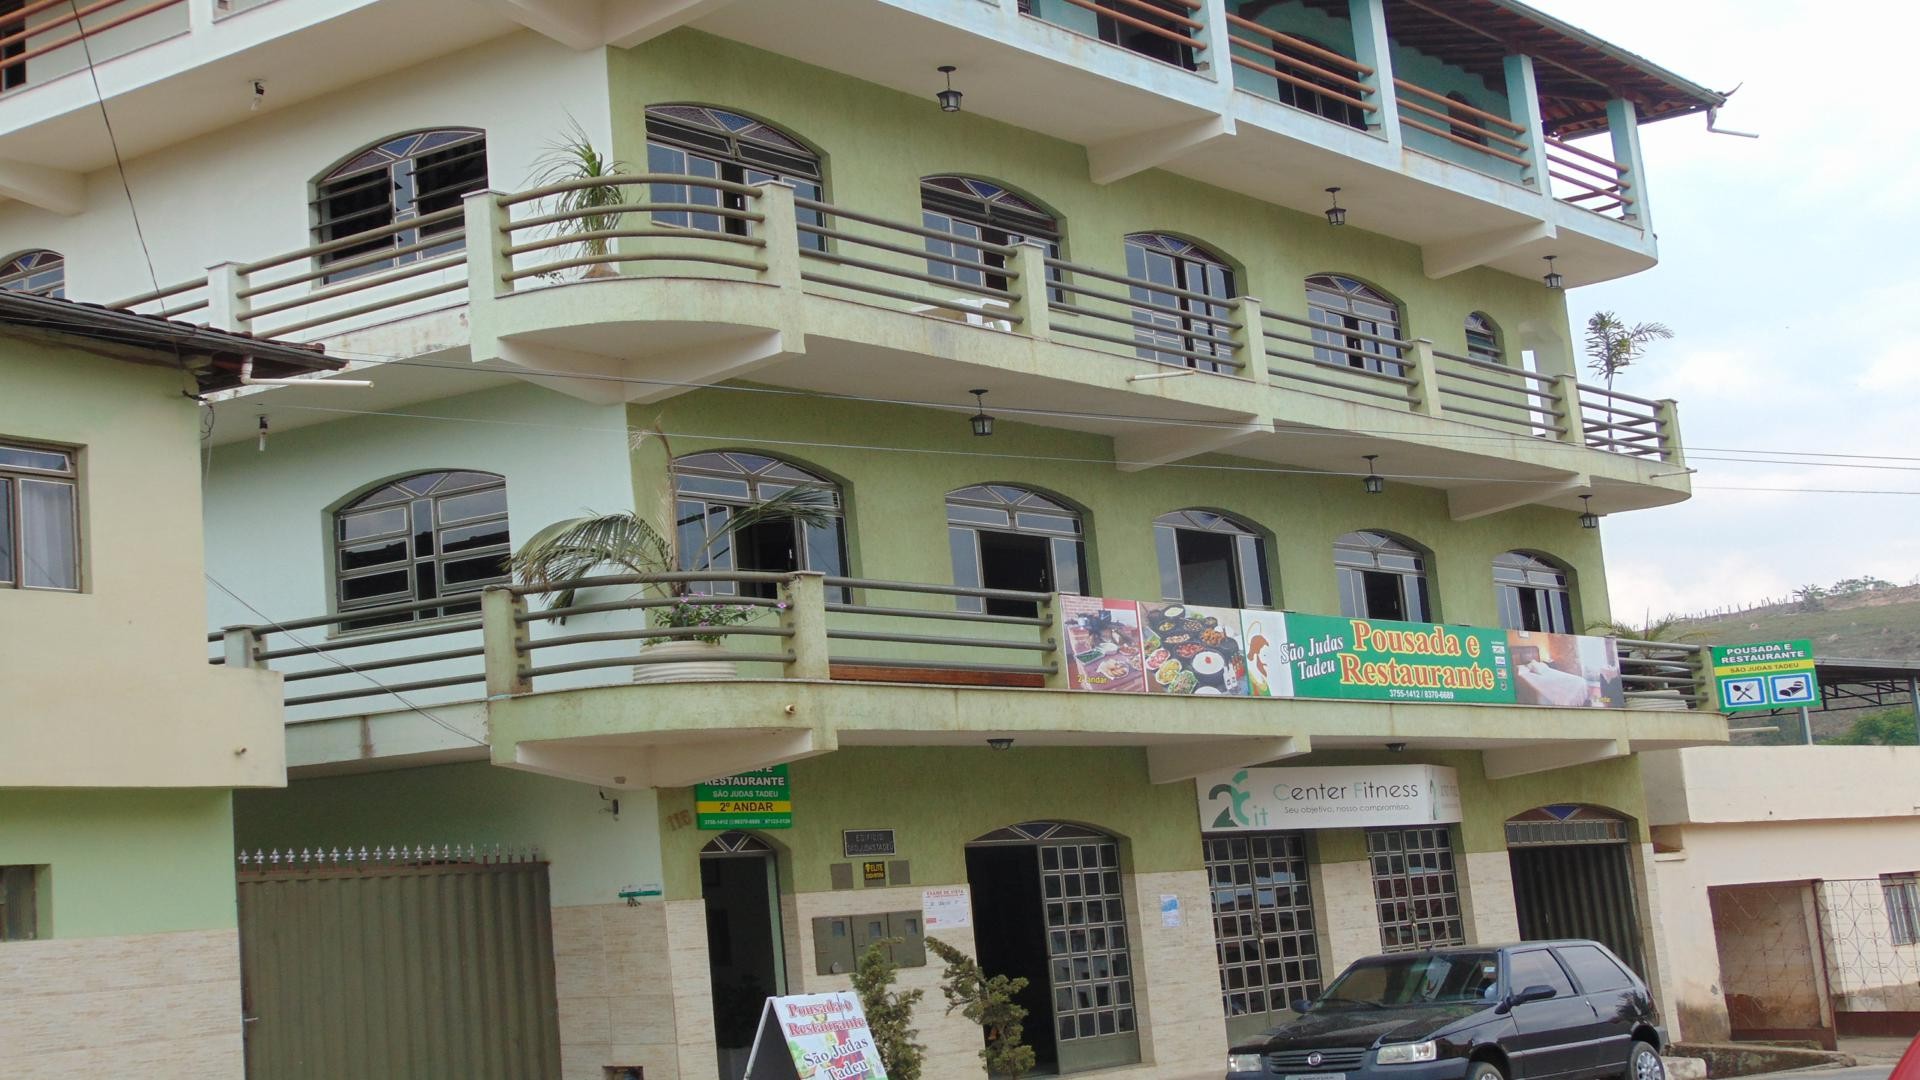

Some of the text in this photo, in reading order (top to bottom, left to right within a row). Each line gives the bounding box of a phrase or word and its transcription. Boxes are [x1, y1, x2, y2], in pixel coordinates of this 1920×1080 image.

[1351, 620, 1480, 657] Pousada e
[1280, 634, 1344, 664] São Judas
[1721, 650, 1805, 664] RESTAURANTE
[1726, 645, 1781, 655] POUSADA
[1297, 657, 1335, 680] Tadeu
[1337, 653, 1495, 689] Restaurante
[1748, 664, 1774, 672] JUDAS
[1775, 662, 1799, 670] TADEU
[730, 790, 754, 798] JUDAS
[755, 790, 779, 798] TADEU
[1273, 781, 1418, 801] Center Fitness
[733, 802, 774, 811] ANDAR
[1284, 805, 1298, 814] Seu
[1336, 805, 1357, 813] nosso
[786, 1000, 842, 1018] Pousada
[786, 1017, 865, 1036] Restaurante
[803, 1038, 868, 1066] São Judas
[824, 1060, 868, 1080] Tadeu
